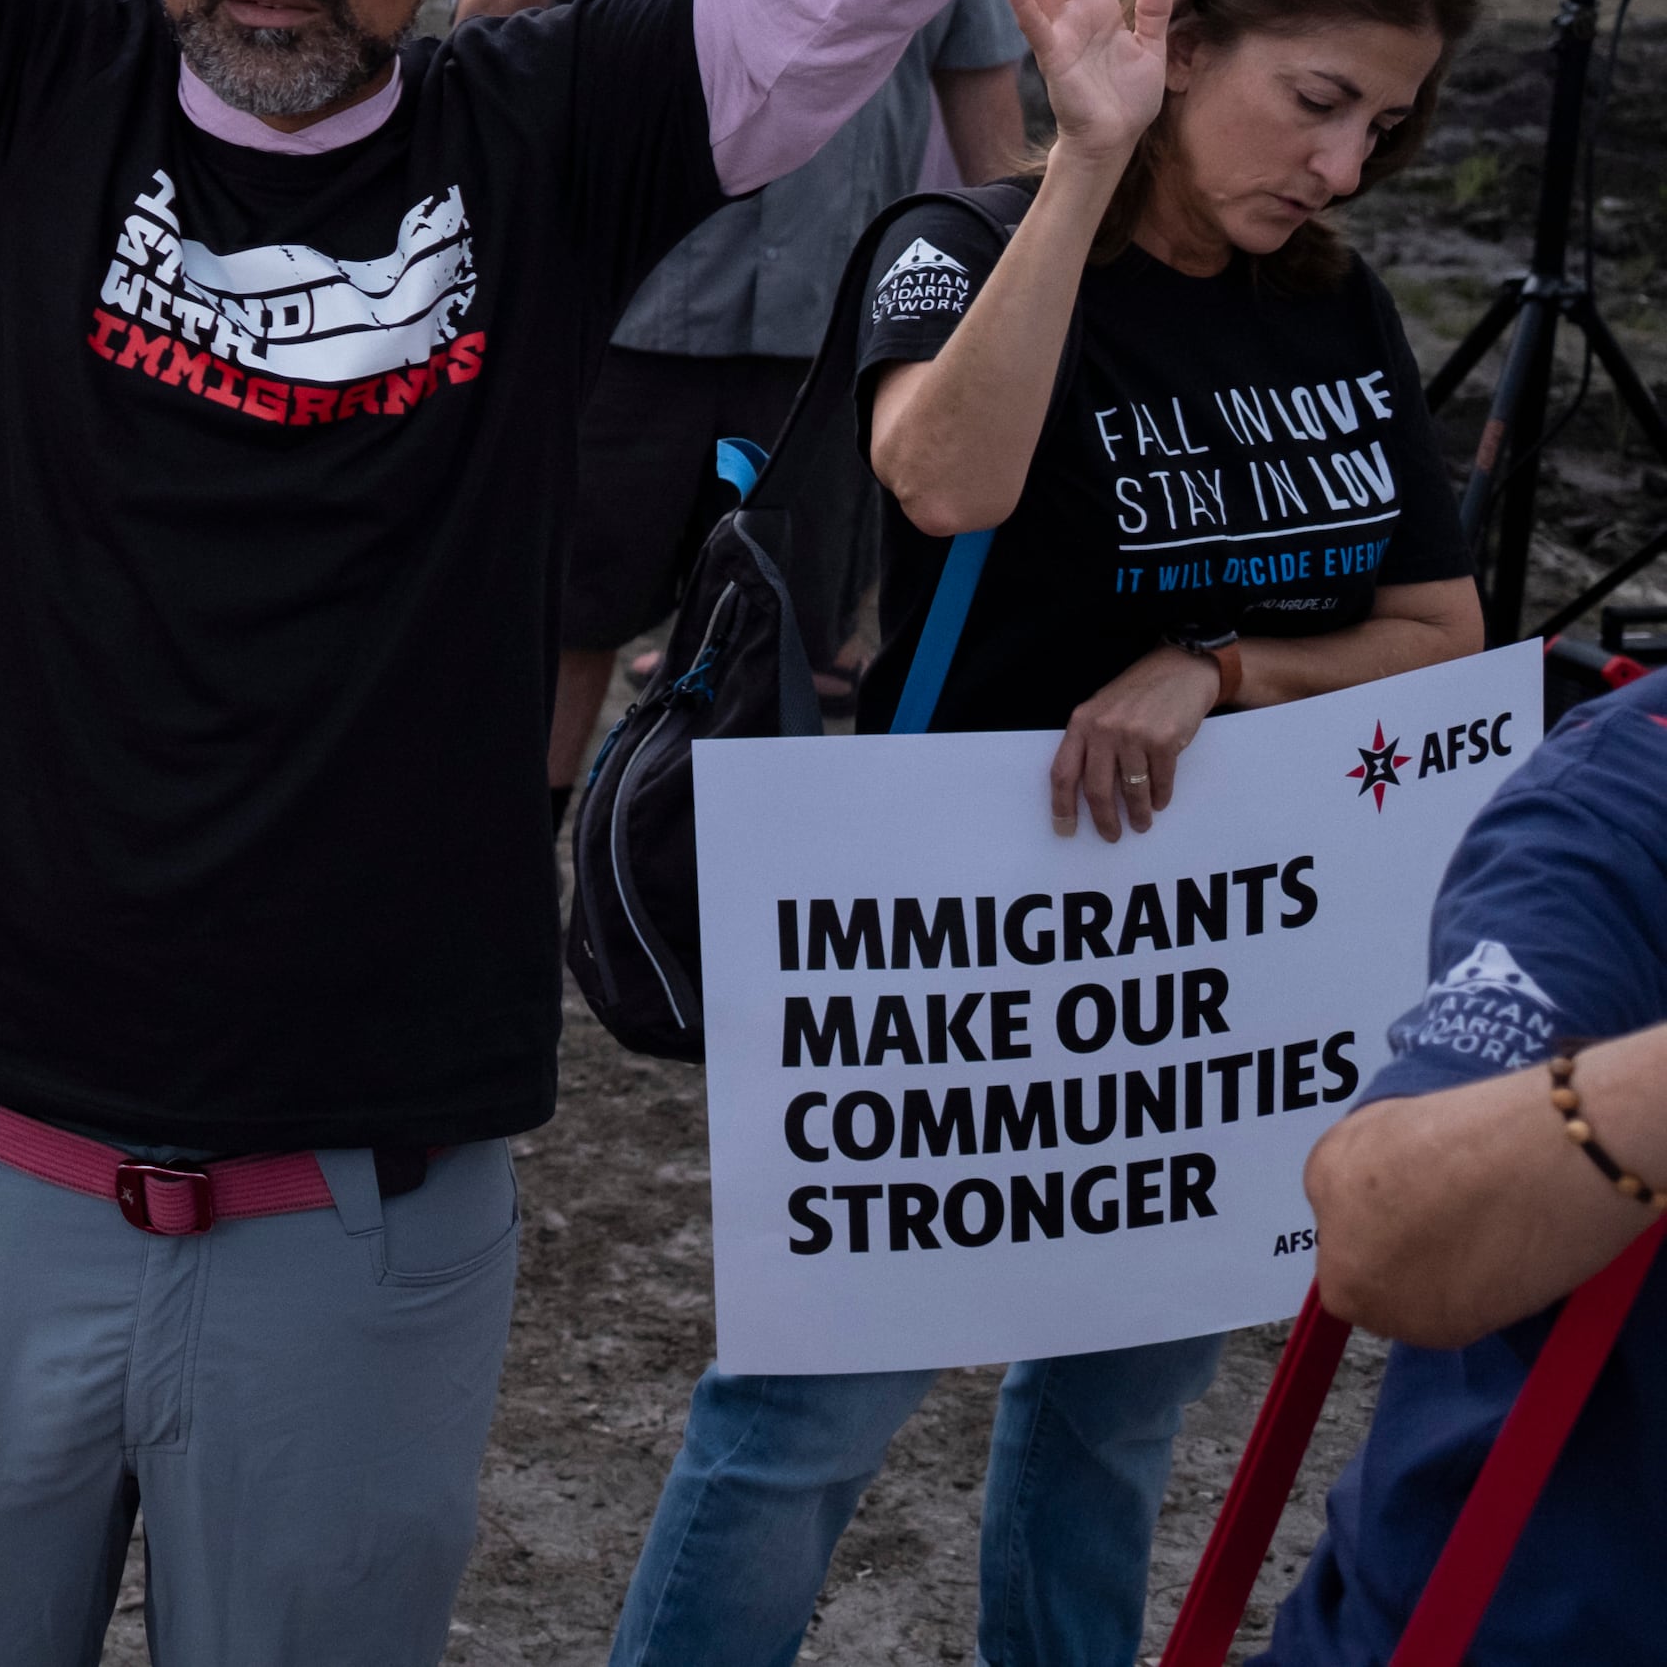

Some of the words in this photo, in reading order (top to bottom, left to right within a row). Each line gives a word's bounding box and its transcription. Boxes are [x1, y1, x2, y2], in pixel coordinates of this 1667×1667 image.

[100, 259, 268, 371] WITH
[116, 215, 315, 338] STND
[886, 299, 964, 314] TWORK
[1095, 397, 1209, 461] FALL
[1214, 386, 1274, 445] IN
[1269, 370, 1393, 441] LOVE
[1116, 469, 1227, 533] STAY
[1250, 460, 1309, 521] IN
[1117, 567, 1144, 593] IT
[1158, 559, 1214, 590] WILL
[1222, 550, 1311, 586] DECIDE
[1417, 711, 1515, 780] AFSC
[776, 855, 1319, 972] IMMIGRANTS
[781, 989, 1032, 1068] MAKE
[1056, 966, 1231, 1055] OUR
[783, 1031, 1360, 1163] COMMUNITIES
[788, 1151, 1218, 1256] STRONGER
